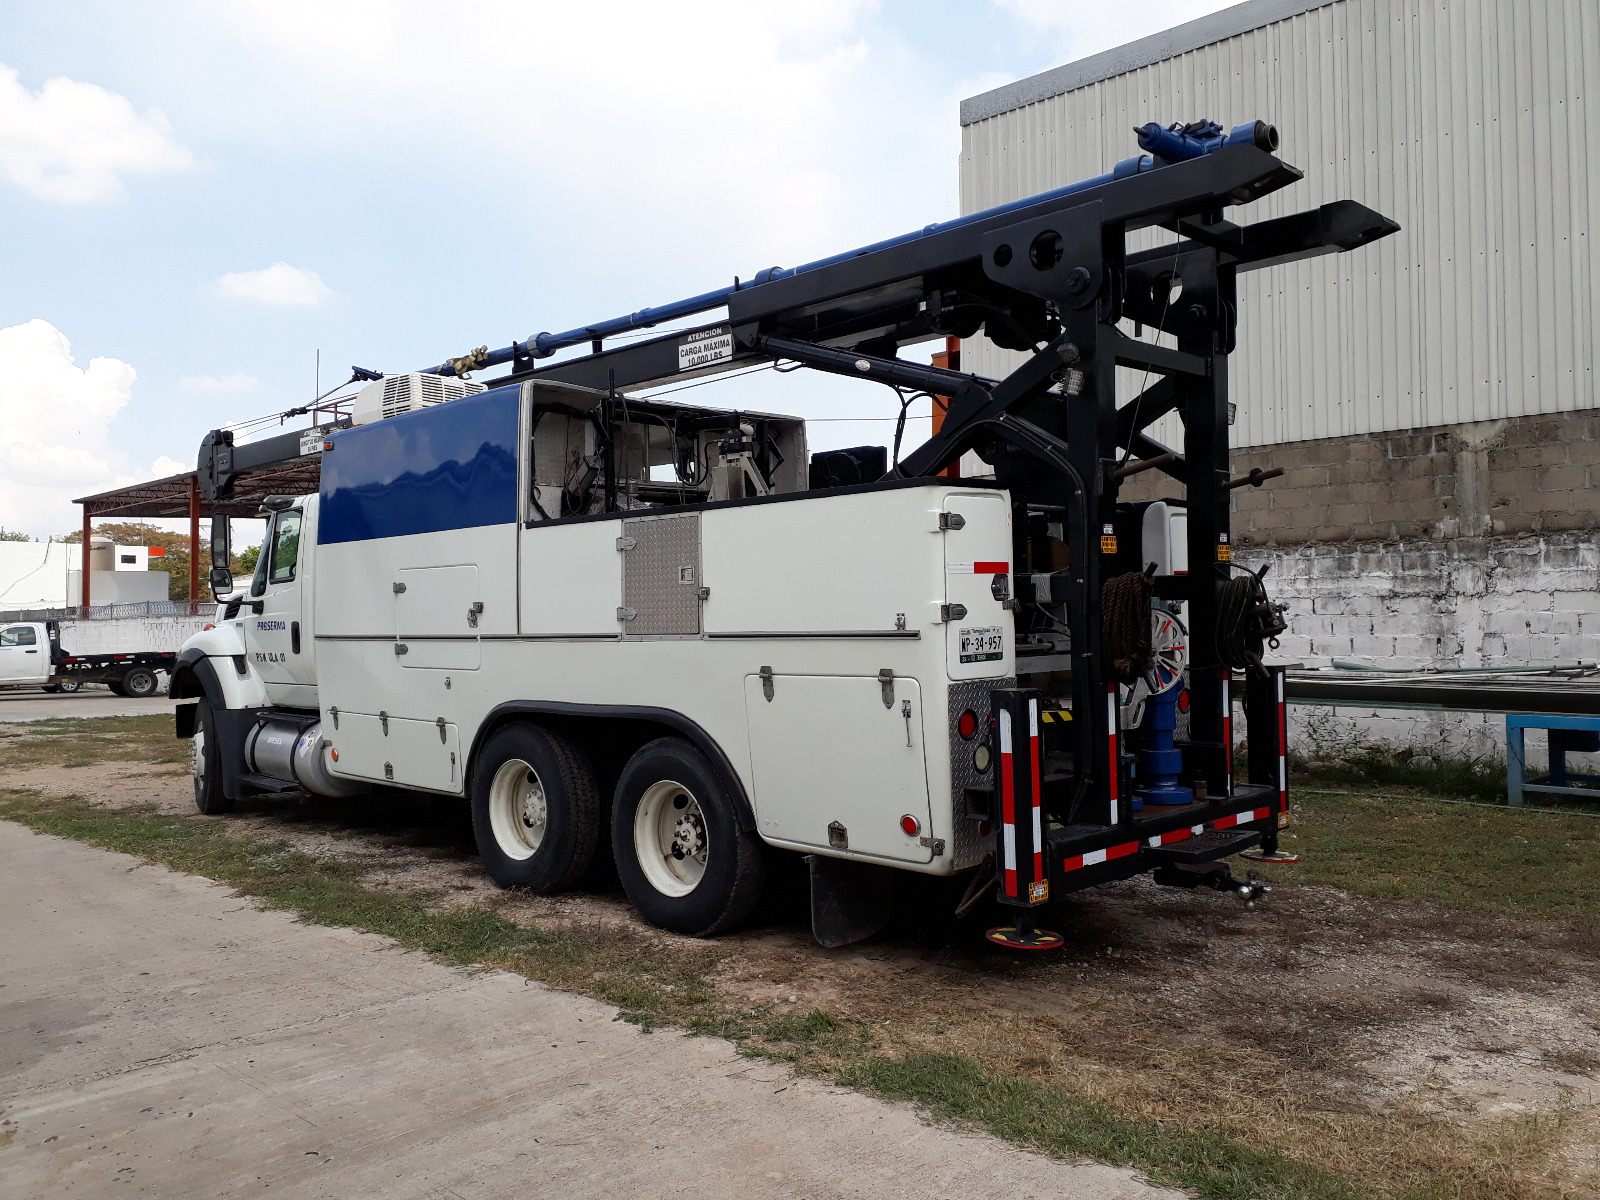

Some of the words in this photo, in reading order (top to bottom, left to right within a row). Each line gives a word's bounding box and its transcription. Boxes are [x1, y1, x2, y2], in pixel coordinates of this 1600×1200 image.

[688, 328, 722, 342] ATENCION
[681, 346, 702, 357] CARGA
[704, 339, 730, 352] MÁXIMA
[710, 351, 723, 360] LBS
